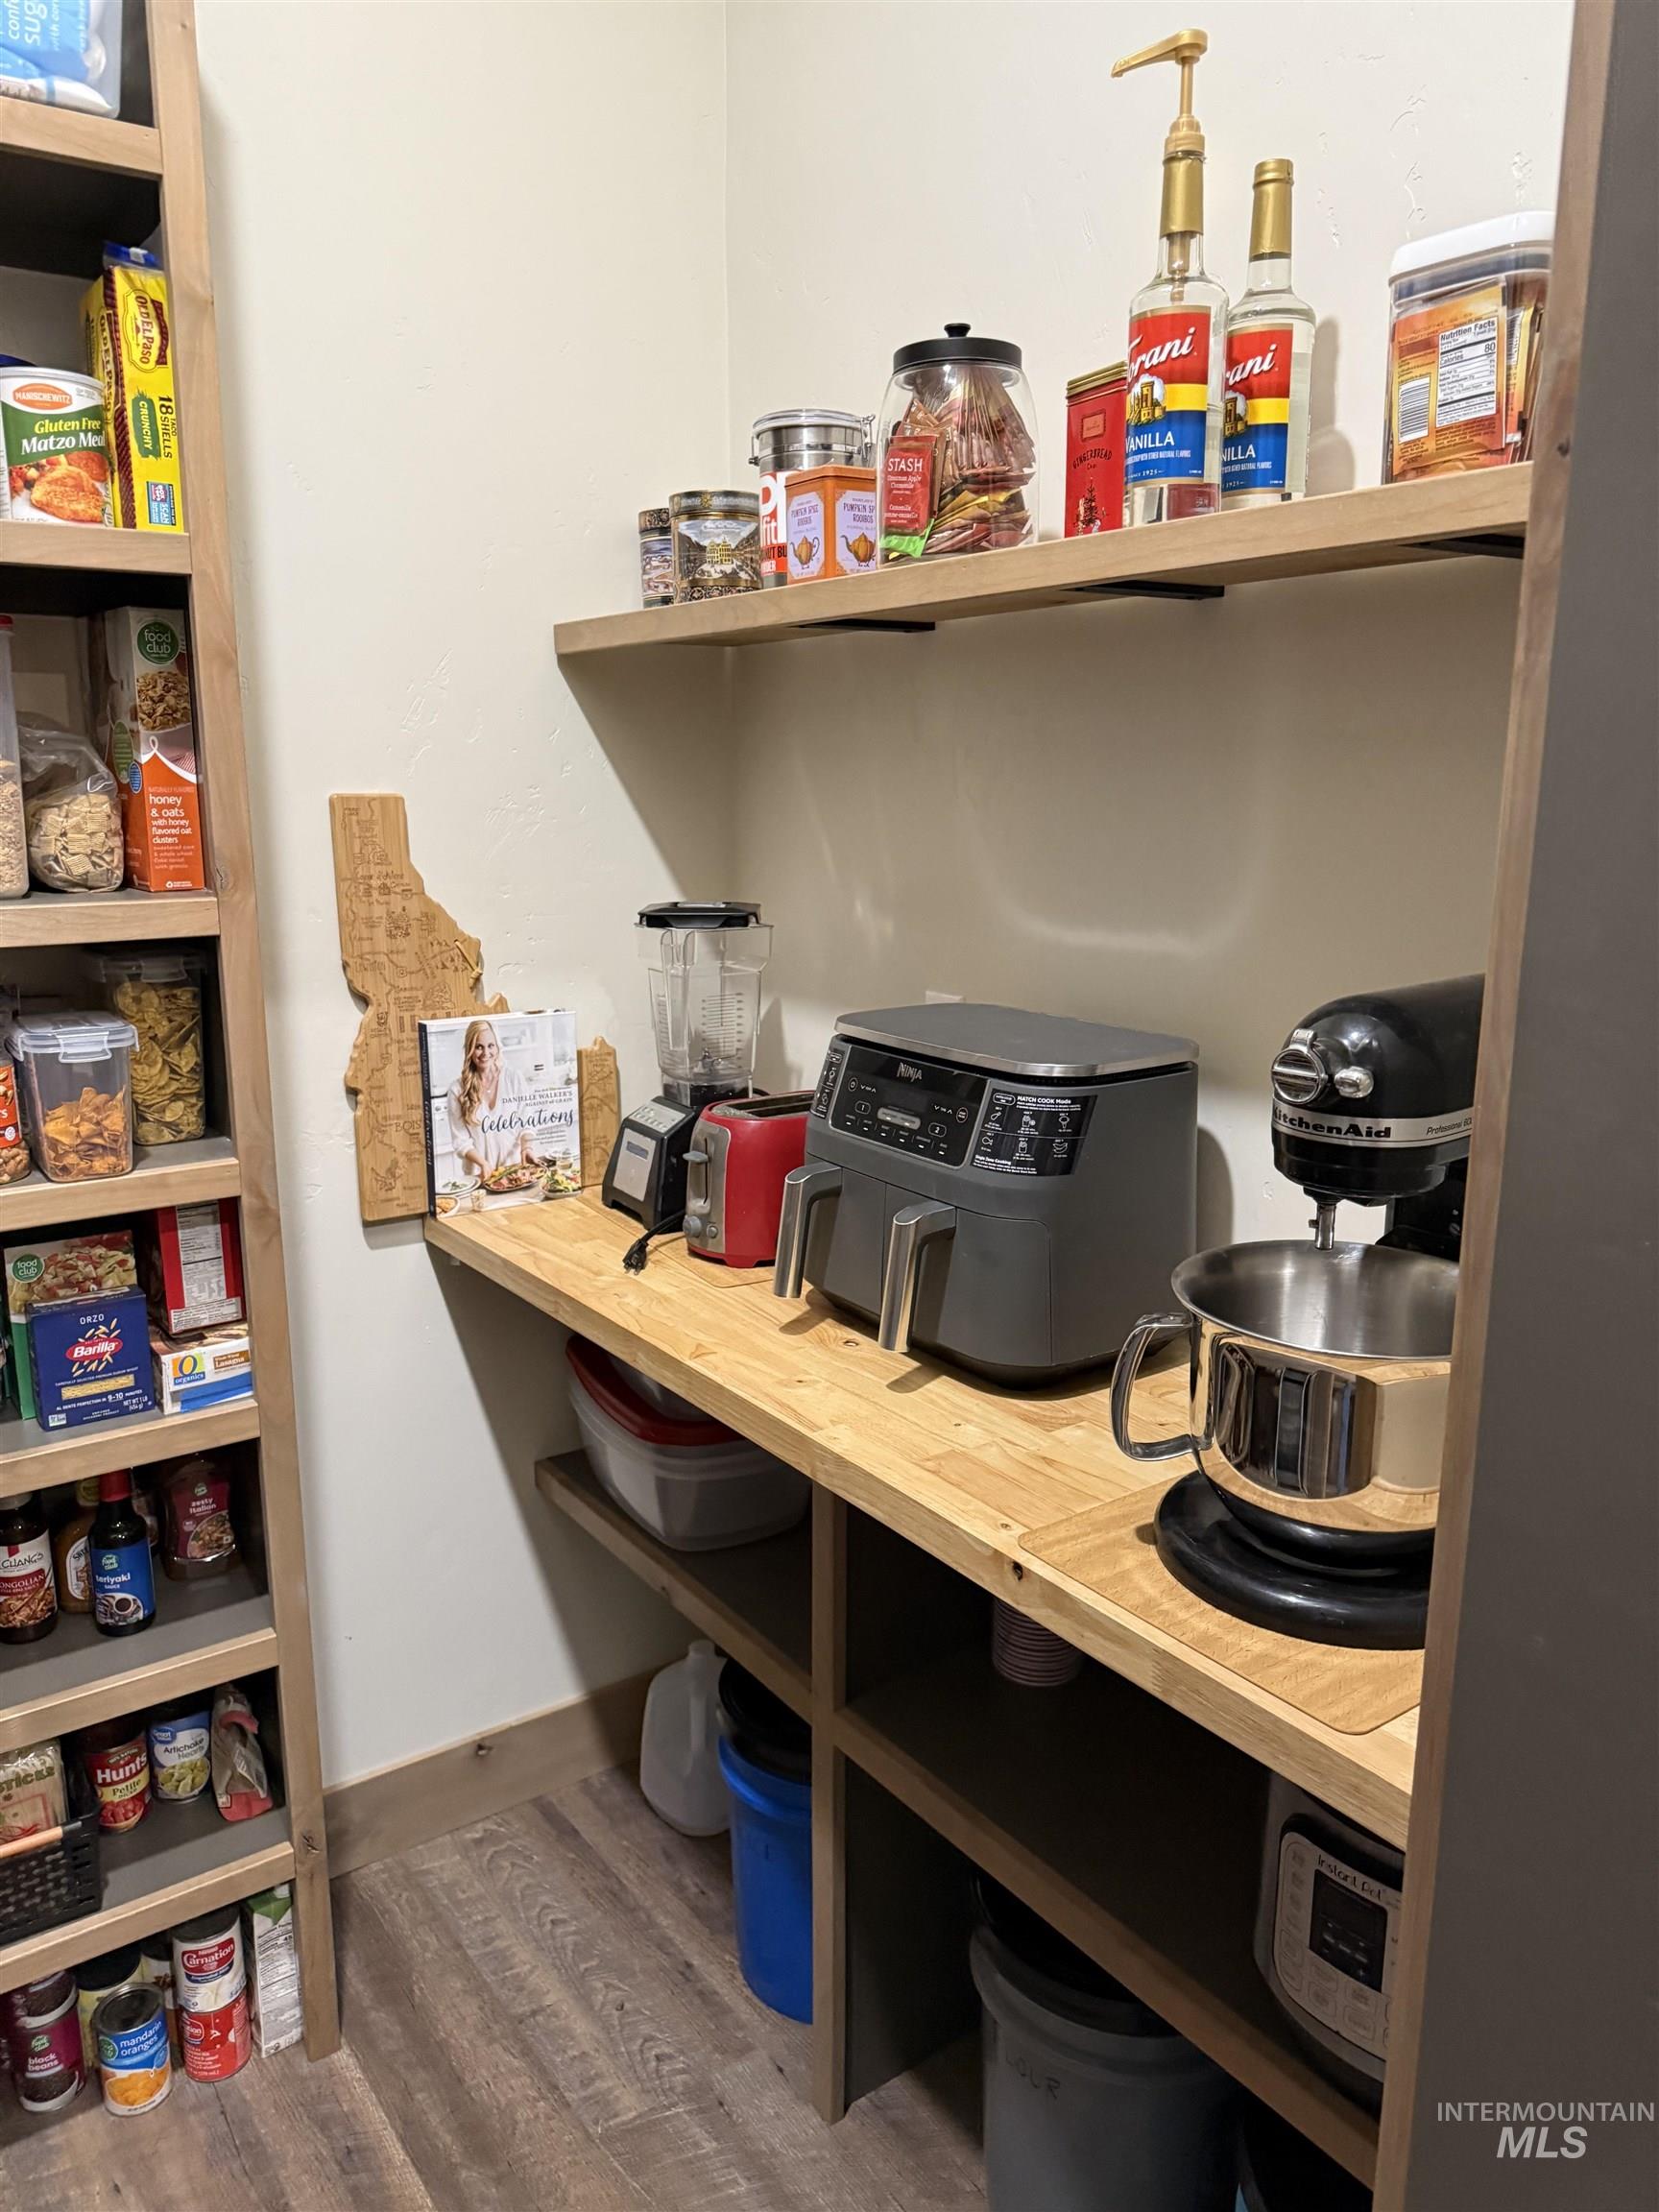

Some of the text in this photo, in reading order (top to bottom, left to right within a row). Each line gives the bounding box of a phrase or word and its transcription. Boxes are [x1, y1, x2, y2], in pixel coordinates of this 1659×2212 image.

[1440, 326, 1473, 341] Nutrition
[1474, 320, 1496, 331] Facts
[1440, 342, 1496, 365] Calories 80
[14, 391, 71, 404] MANISCHEWITZ
[35, 417, 102, 434] Gluten Free
[139, 400, 153, 450] CRUNCHY
[158, 395, 174, 459] 18 SHELLS
[21, 431, 106, 455] Matzo Meal
[1125, 430, 1175, 454] VANILLA
[888, 458, 923, 471] STASH
[1073, 447, 1113, 469] GINGERBREAD
[908, 474, 922, 483] Apple
[843, 502, 868, 513] PUMPKIN
[853, 514, 874, 524] ROOIBOS
[145, 630, 171, 641] food
[146, 642, 171, 654] club
[149, 793, 182, 806] honey
[150, 807, 184, 817] & oats
[152, 827, 180, 835] flavored
[897, 1062, 923, 1083] NINJA
[502, 1094, 537, 1104] DANIELLE
[539, 1090, 573, 1100] WALKER'S
[395, 1120, 421, 1133] BOIS
[481, 1108, 574, 1134] Celebrations
[1273, 1106, 1392, 1139] KitchenAid
[1426, 1120, 1463, 1136] Professional
[17, 1259, 37, 1267] food
[18, 1266, 37, 1275] club
[80, 1313, 105, 1325] ORZO
[73, 1341, 116, 1358] Barilla
[215, 1357, 245, 1368] Lasagna
[175, 1373, 204, 1383] organics
[108, 1393, 124, 1402] 9-10
[189, 1503, 217, 1514] Italian
[163, 1737, 204, 1754] Artichoke
[178, 1744, 206, 1761] Hearts
[111, 1779, 142, 1796] Petite
[1318, 1854, 1381, 1901] Instant Pot
[182, 1942, 235, 1968] Carnation
[119, 2021, 162, 2048] mandarin
[121, 2035, 159, 2056] oranges
[28, 2053, 58, 2065] black
[28, 2060, 60, 2072] beans
